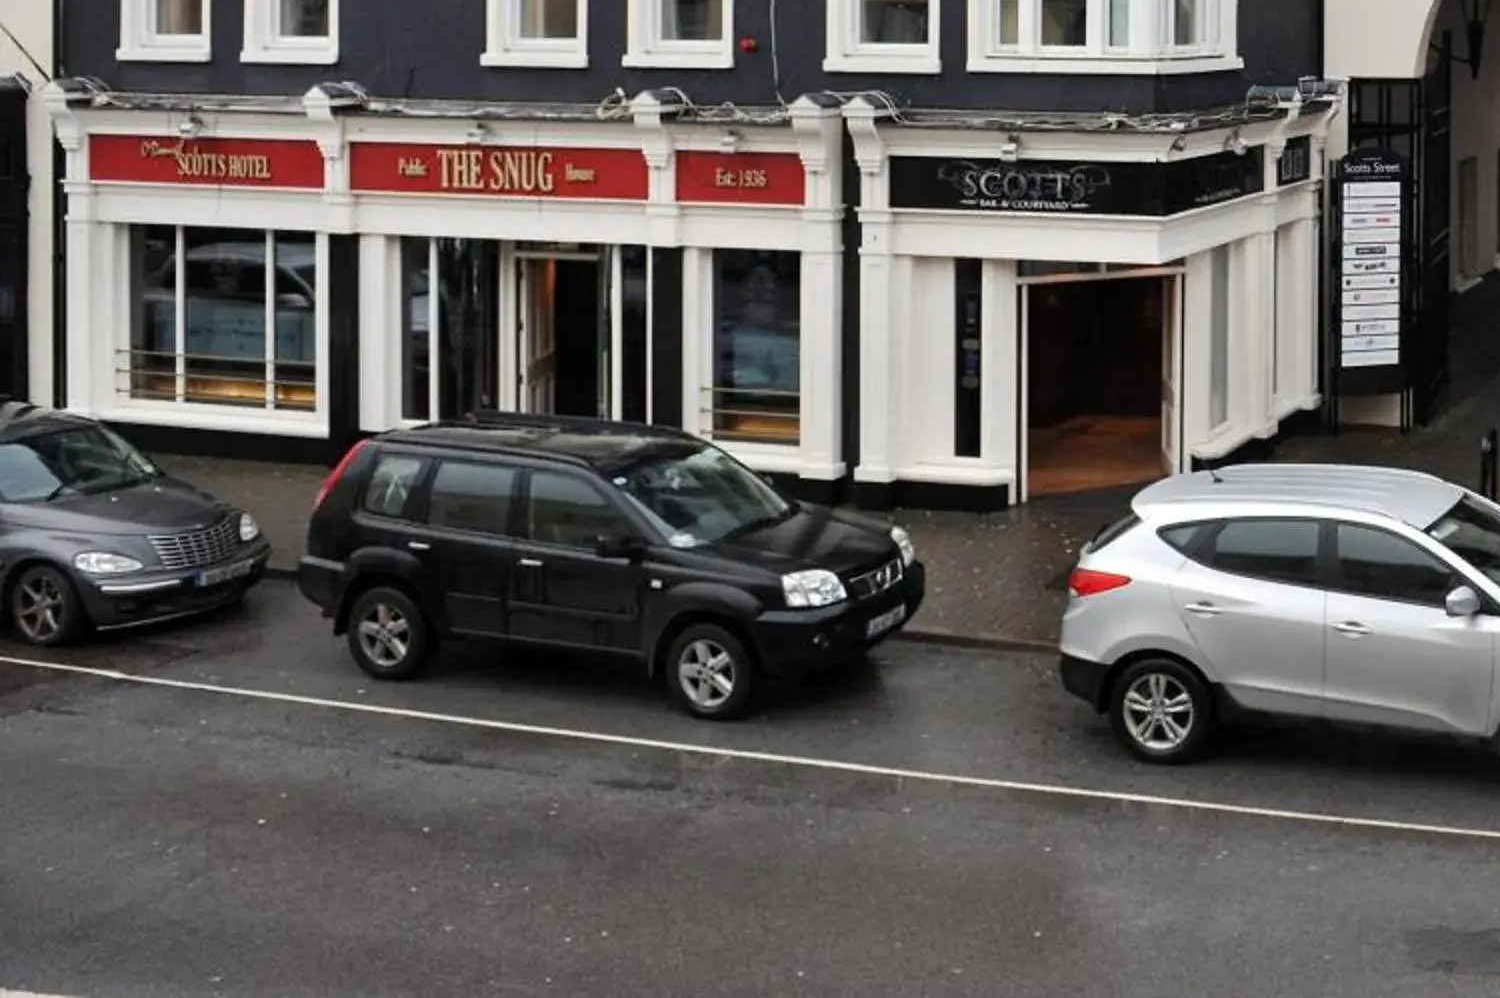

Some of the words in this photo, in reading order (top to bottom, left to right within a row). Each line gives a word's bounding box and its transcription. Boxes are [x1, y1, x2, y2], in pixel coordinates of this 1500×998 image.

[176, 153, 227, 179] SCOTTS
[228, 155, 271, 180] HOTEL
[437, 149, 485, 190] THE
[488, 151, 555, 192] SNUG
[1344, 162, 1371, 174] Scotts
[1373, 162, 1400, 174] Street
[962, 169, 1087, 202] SCOTTS
